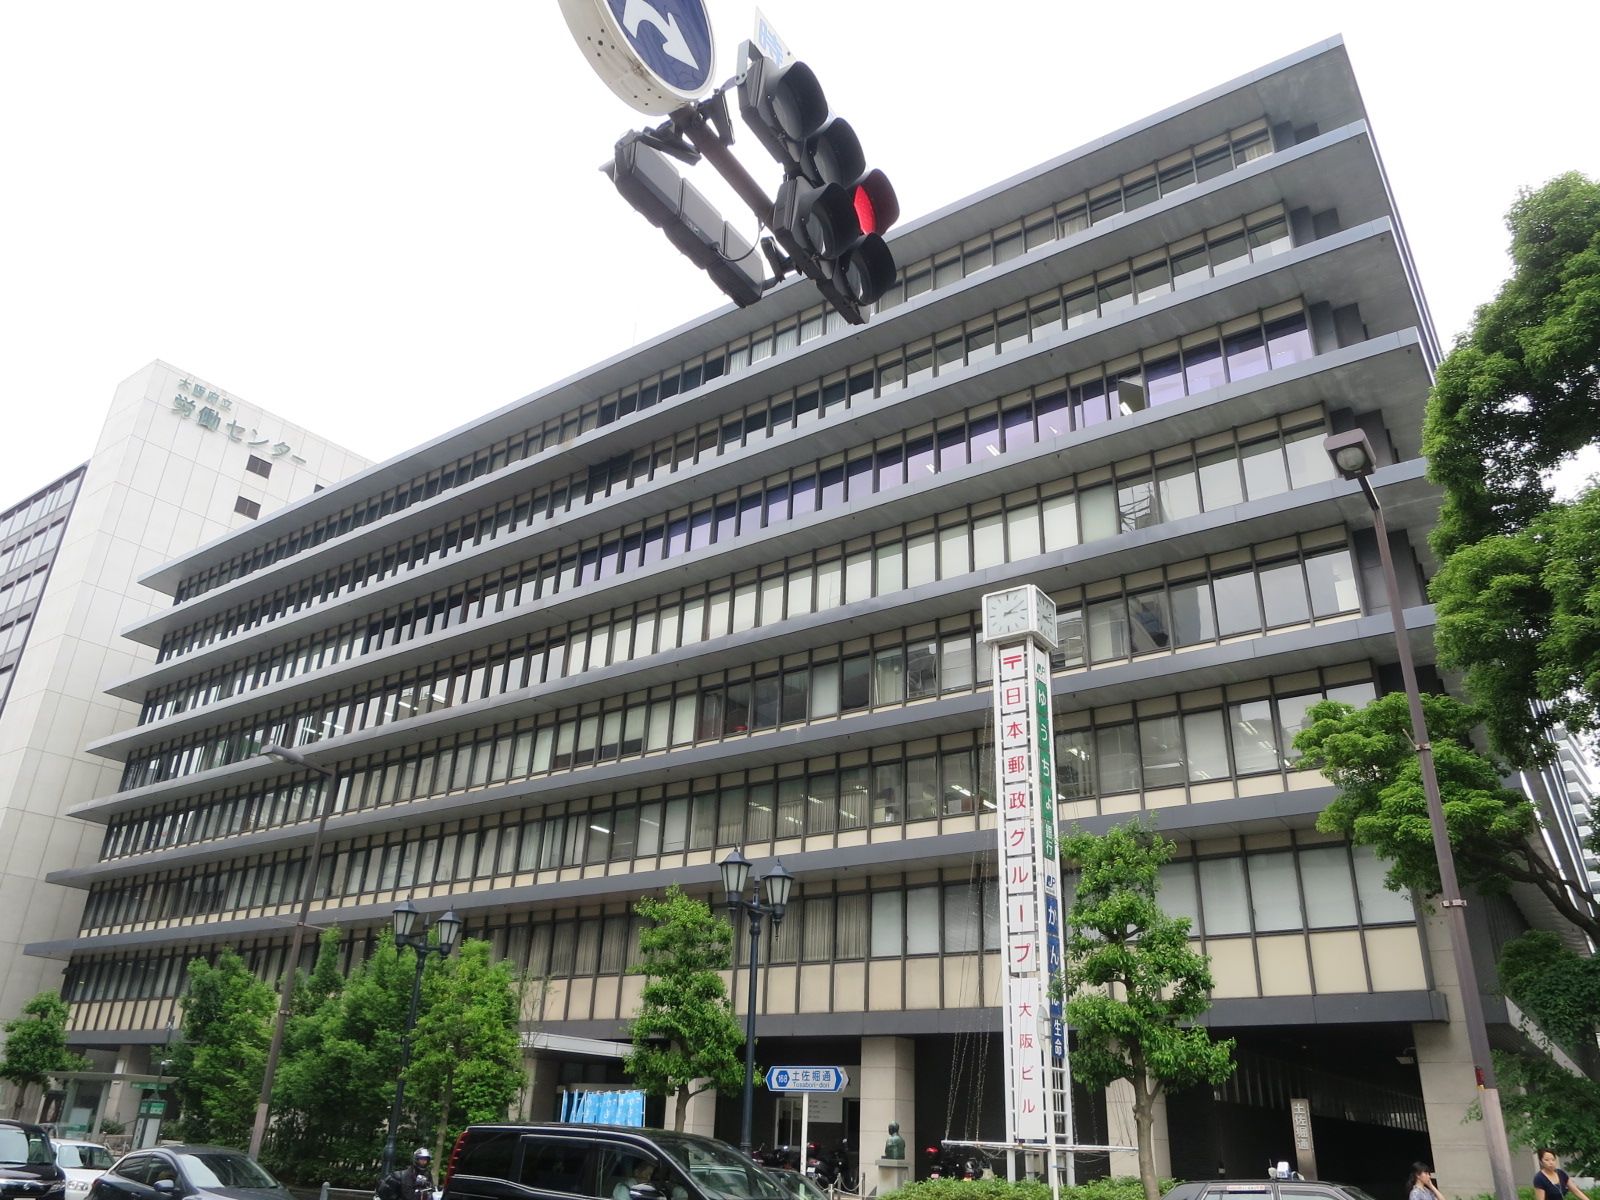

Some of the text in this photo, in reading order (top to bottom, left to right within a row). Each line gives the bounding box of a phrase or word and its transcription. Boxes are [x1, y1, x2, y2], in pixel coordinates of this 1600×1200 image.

[171, 394, 307, 464] 労働センター
[1006, 687, 1031, 962] 日本郵政グループ
[791, 1070, 831, 1082] 土佐堀通
[1018, 1001, 1036, 1114] 大阪ビル
